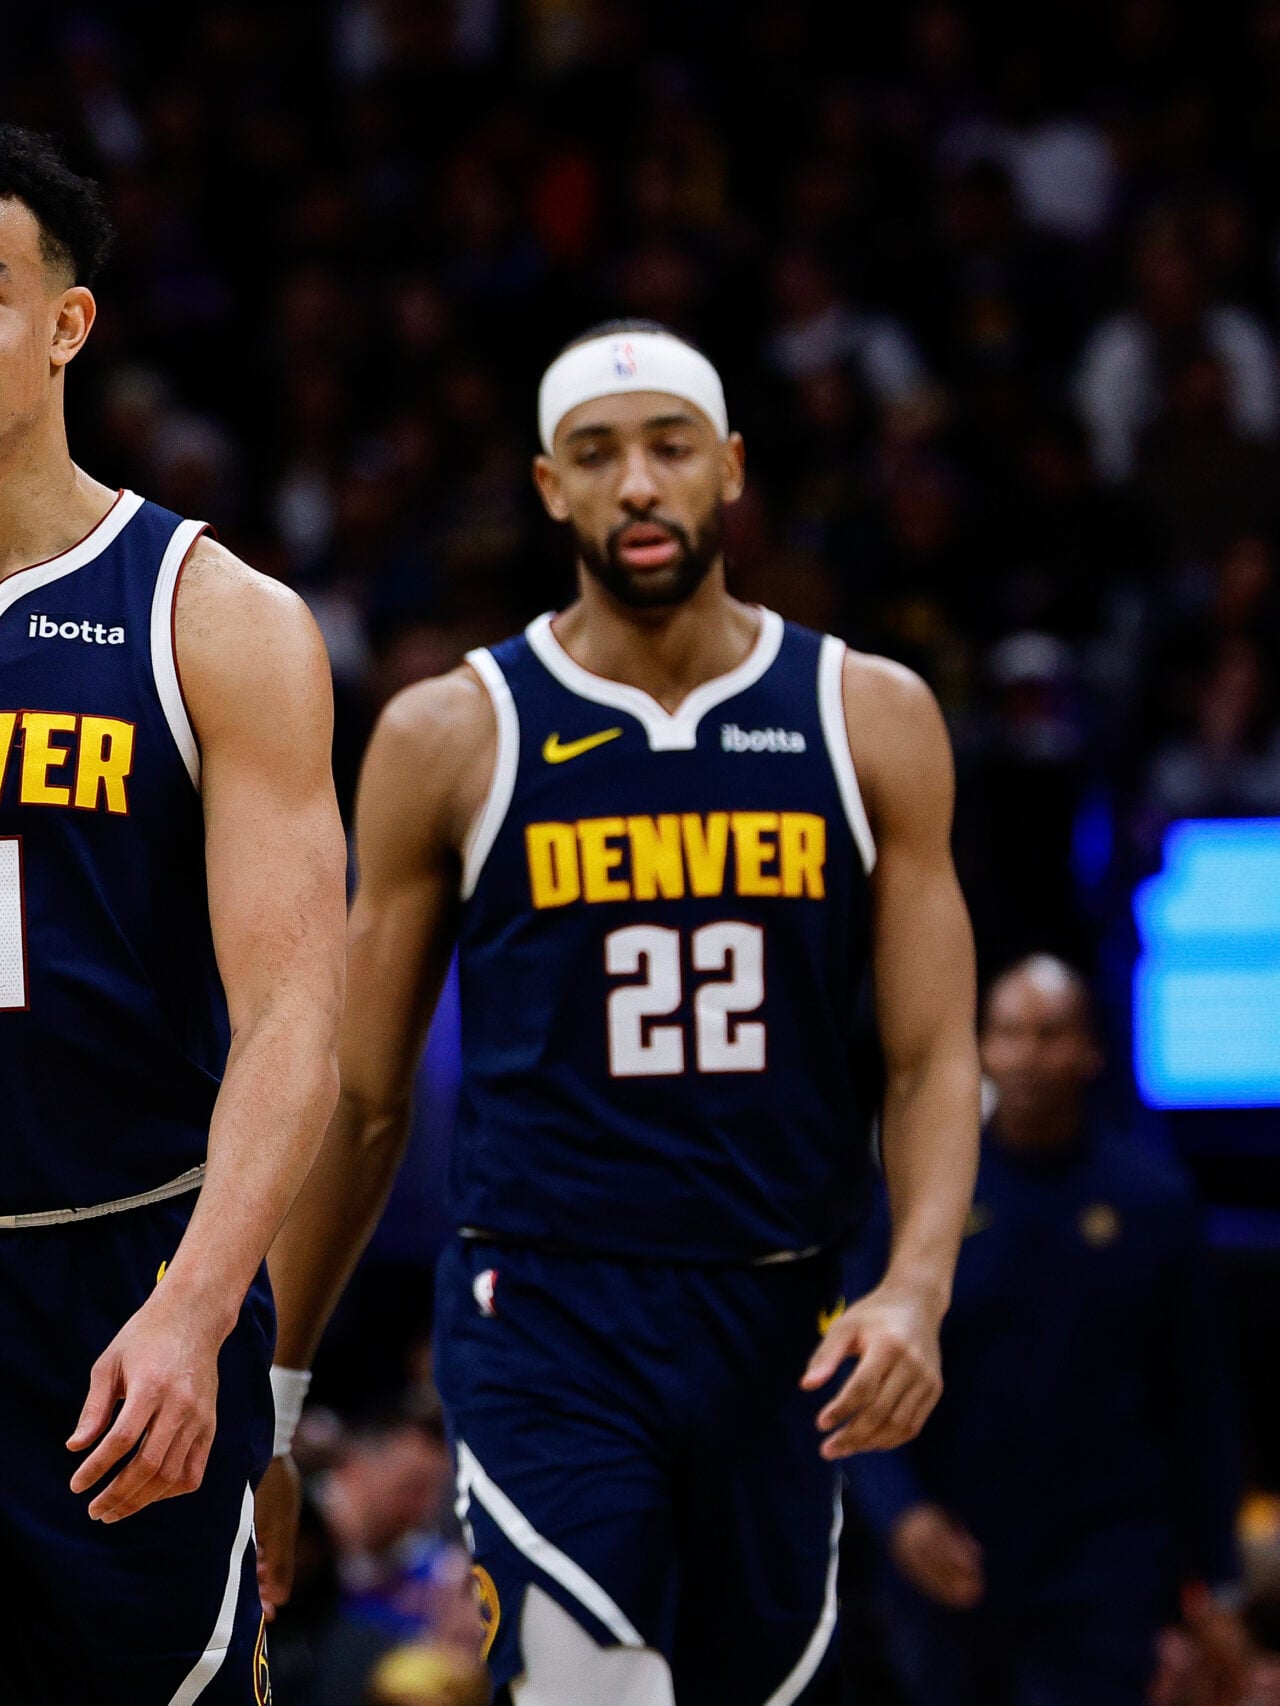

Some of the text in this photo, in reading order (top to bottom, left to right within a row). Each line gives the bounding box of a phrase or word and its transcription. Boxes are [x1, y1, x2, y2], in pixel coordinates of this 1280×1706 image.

[28, 614, 125, 645] ibotta
[722, 724, 806, 754] ibotta
[524, 810, 827, 909] DENVER
[604, 919, 767, 1078] 22
